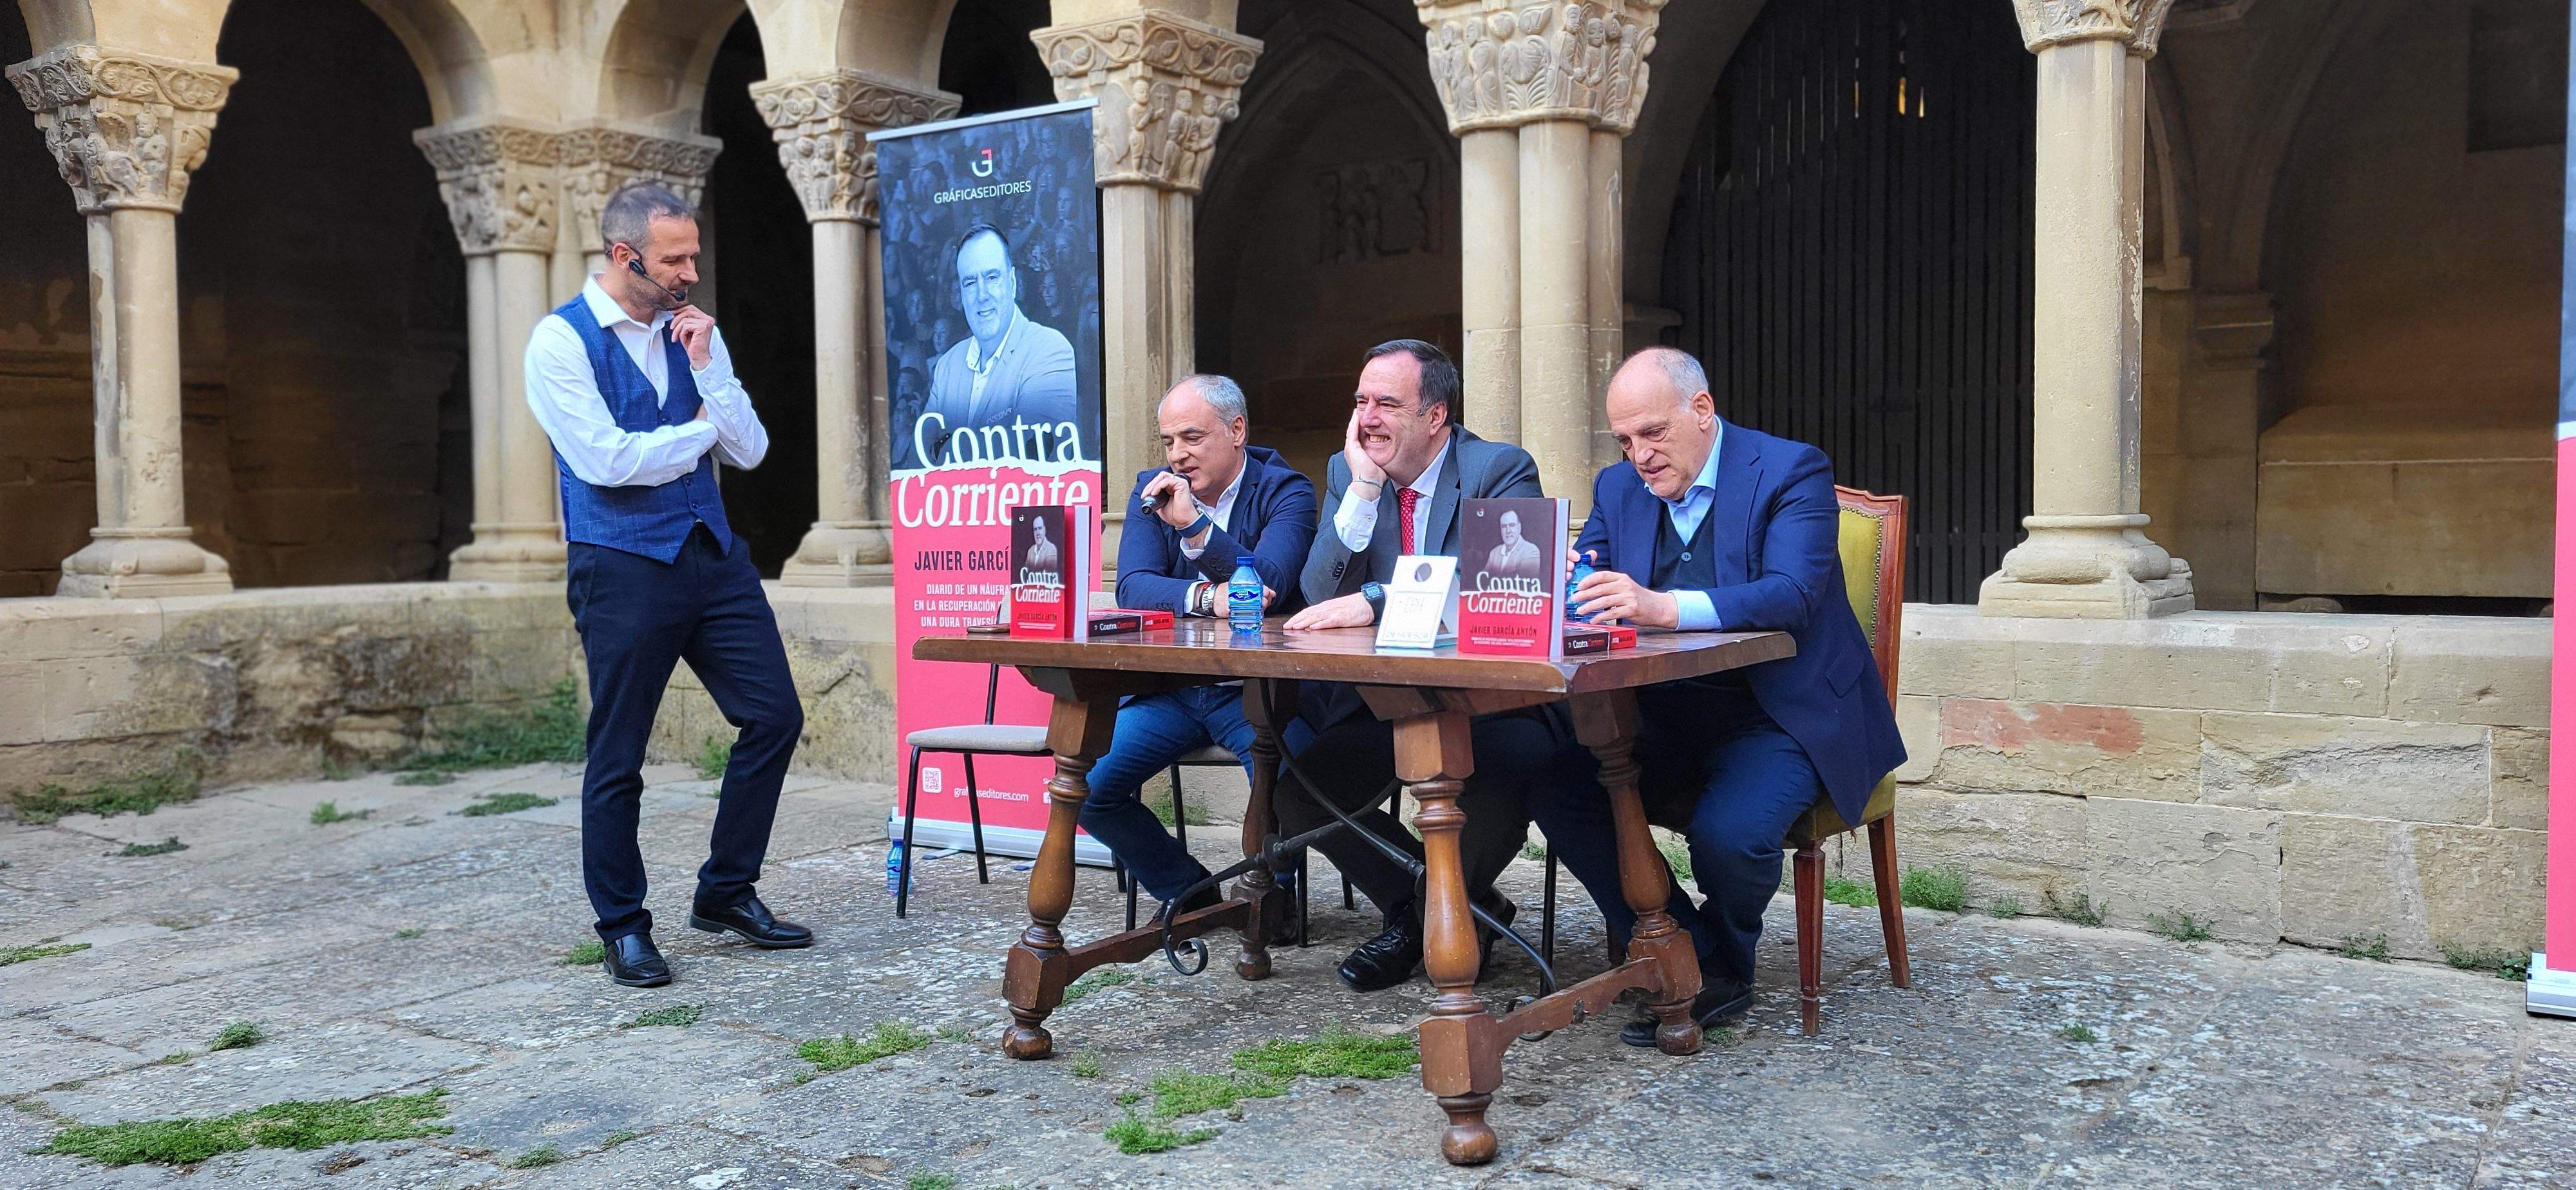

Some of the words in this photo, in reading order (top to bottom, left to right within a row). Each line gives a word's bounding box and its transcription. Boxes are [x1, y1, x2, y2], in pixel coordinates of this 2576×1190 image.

[934, 180, 1032, 204] GRÁFICASEDITORES
[914, 412, 1083, 470] Contra
[914, 551, 963, 571] JAVIER
[1020, 567, 1059, 585] Contra
[1476, 571, 1541, 592] Contra
[927, 583, 952, 595] DIARIO
[955, 584, 965, 595] DE
[967, 584, 978, 595] UN
[914, 600, 924, 611] EN
[926, 601, 936, 611] LA
[939, 599, 996, 612] RECUPERACIÓN
[1468, 592, 1544, 616] Corriente
[921, 616, 937, 627] UNA
[940, 617, 960, 628] DURA
[1099, 623, 1117, 631] Contra
[1470, 625, 1491, 634] JAVIER
[1492, 625, 1515, 636] GARCÍA
[1516, 627, 1538, 637] ANTÓN
[1573, 639, 1589, 649] Contra
